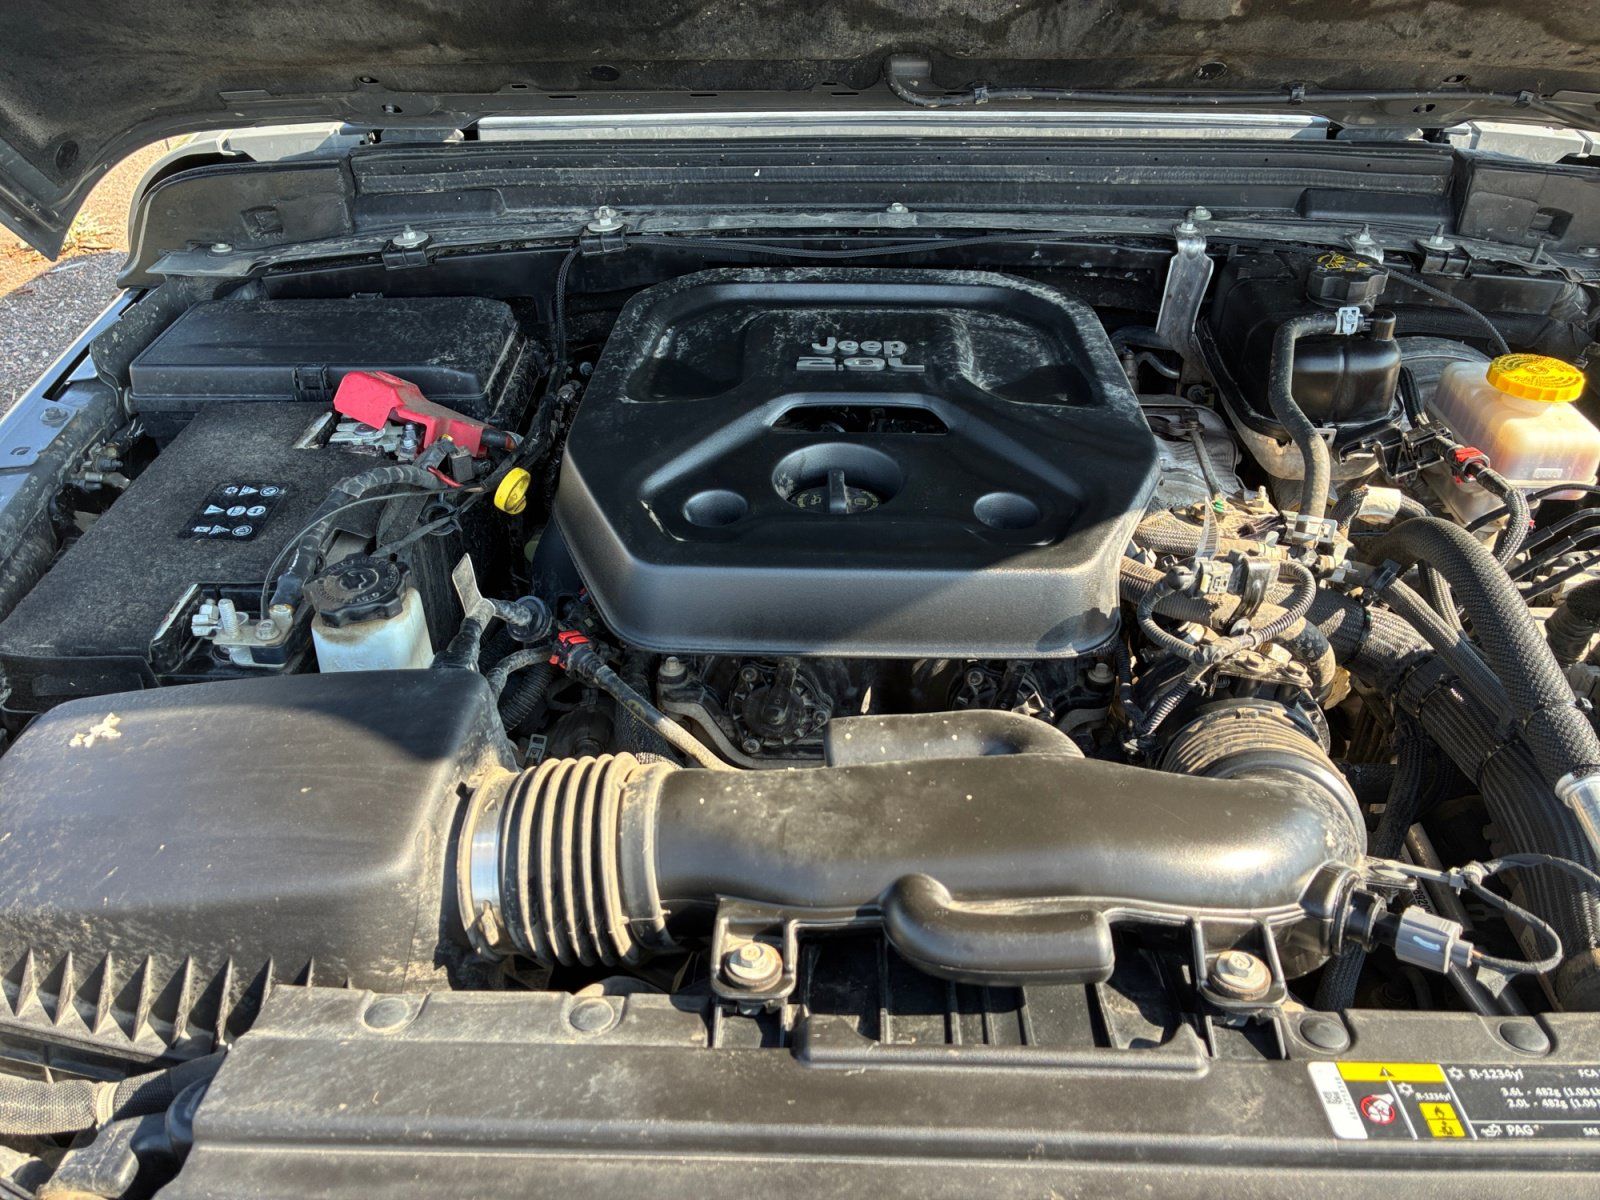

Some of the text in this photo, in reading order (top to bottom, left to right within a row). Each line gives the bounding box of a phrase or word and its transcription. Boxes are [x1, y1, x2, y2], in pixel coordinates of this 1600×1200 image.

[811, 336, 907, 357] Jeep
[796, 356, 925, 372] 2.0L
[1469, 1068, 1523, 1081] R-1234yf
[1578, 1068, 1599, 1078] FCA
[1501, 1087, 1524, 1097] 3.6L
[1535, 1087, 1561, 1098] 482g
[1507, 1098, 1530, 1108] 2.0L
[1541, 1098, 1568, 1109] 482g
